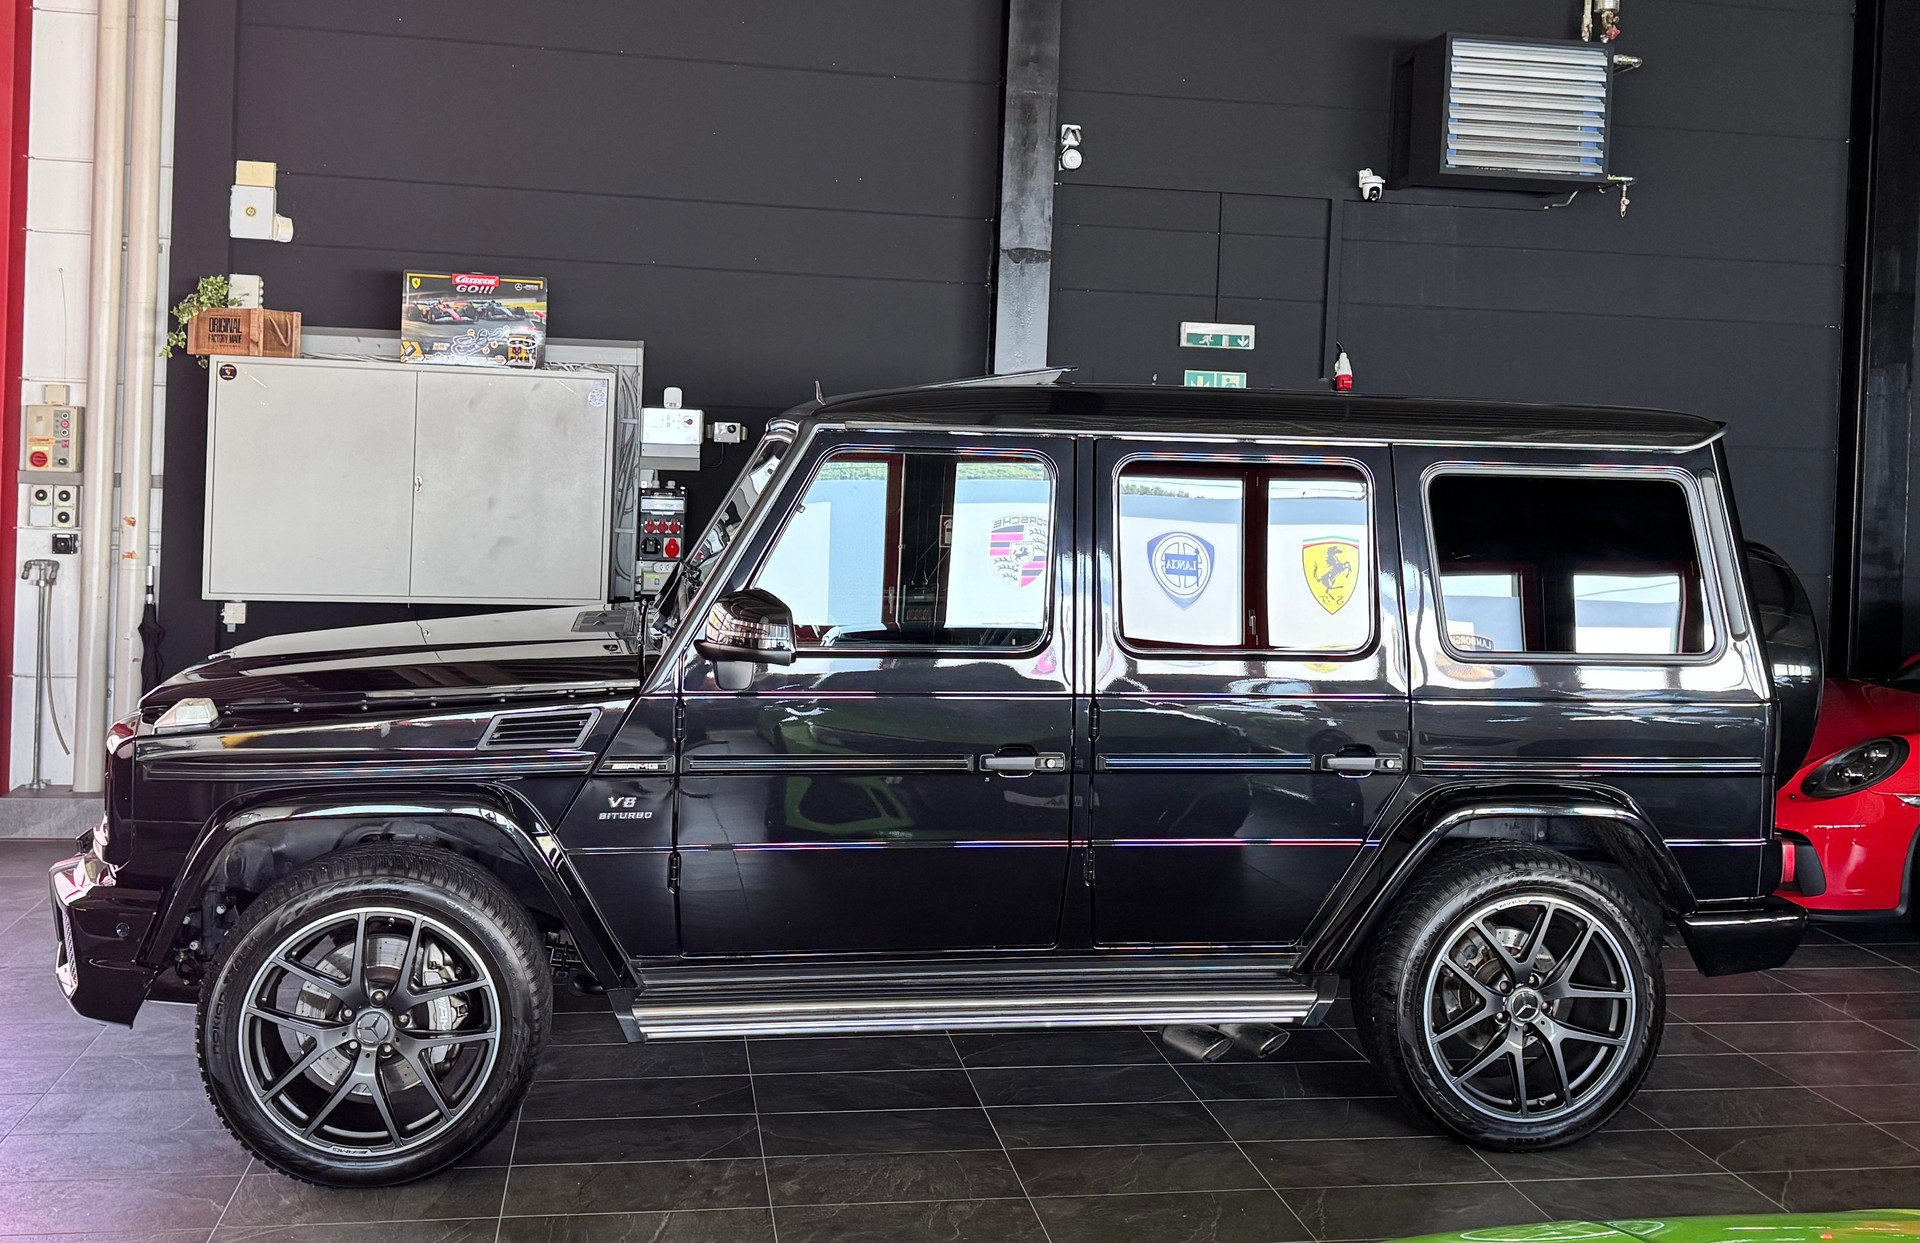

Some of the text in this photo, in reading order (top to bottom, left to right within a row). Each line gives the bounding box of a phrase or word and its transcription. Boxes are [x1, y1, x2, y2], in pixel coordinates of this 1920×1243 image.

[455, 275, 496, 286] Carrera
[456, 284, 496, 295] GO!!!
[208, 317, 242, 333] ORIGINAL
[208, 333, 228, 343] FACTORY
[608, 796, 637, 808] V8
[598, 811, 653, 820] BITURBO
